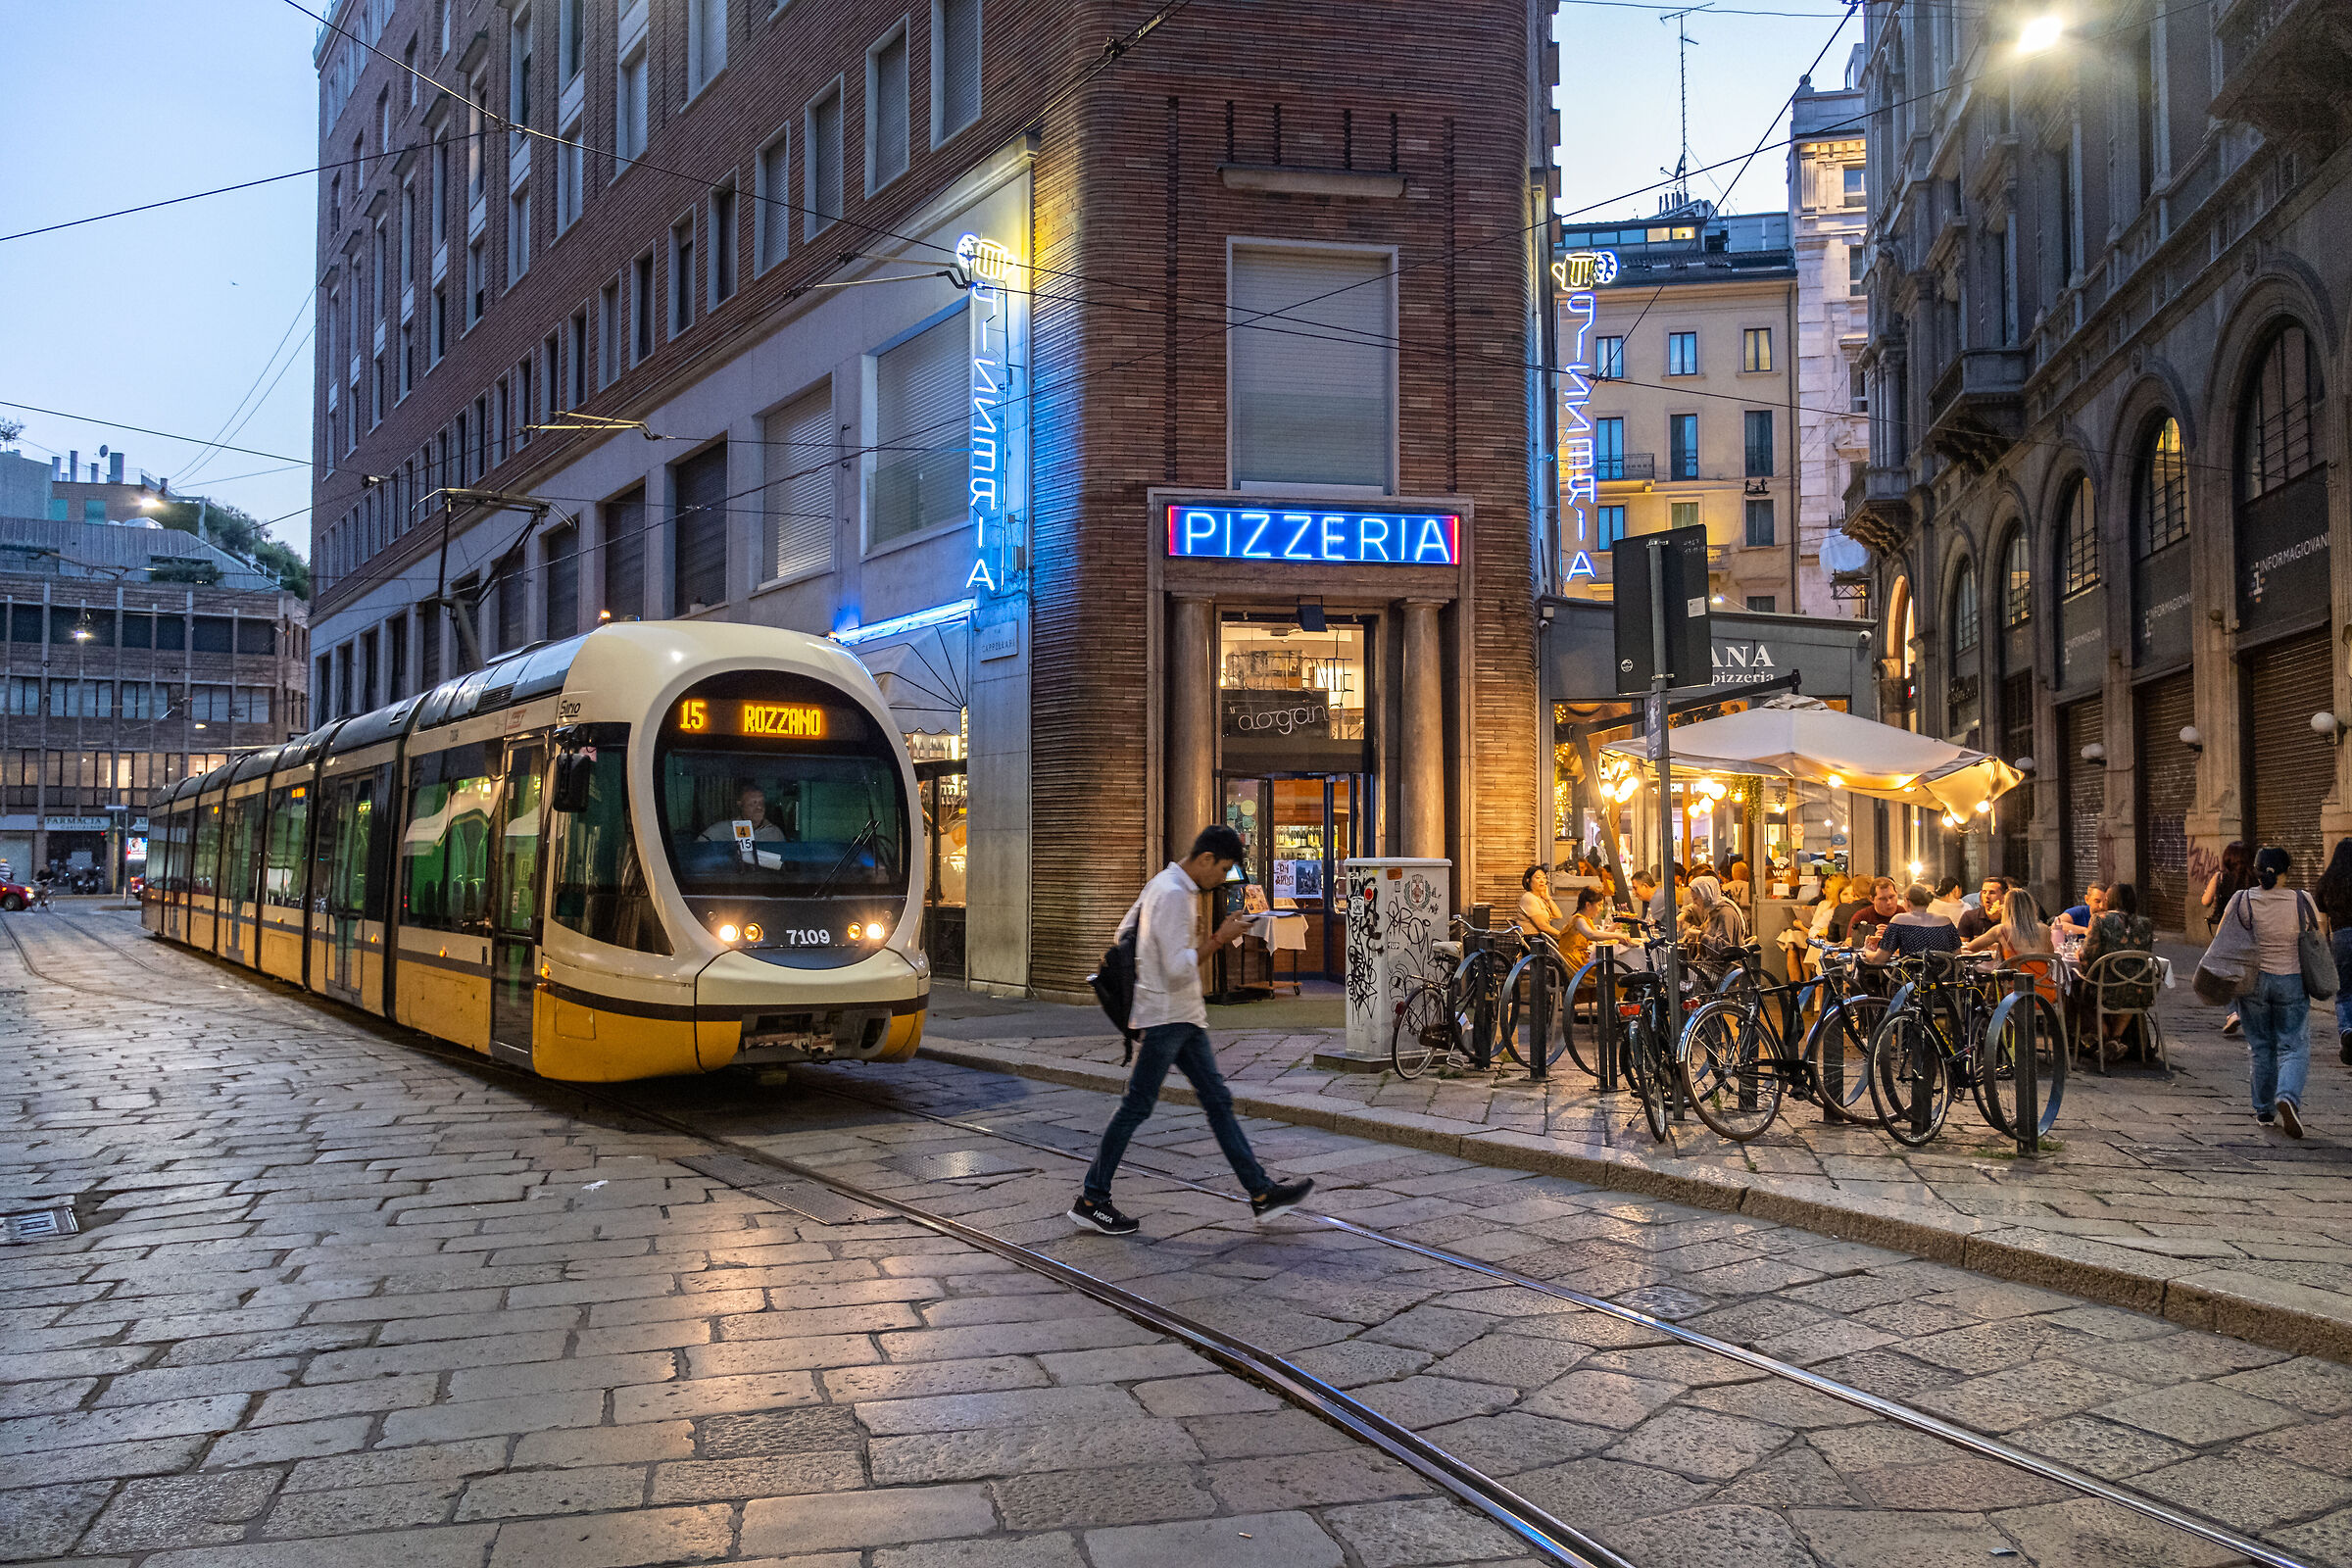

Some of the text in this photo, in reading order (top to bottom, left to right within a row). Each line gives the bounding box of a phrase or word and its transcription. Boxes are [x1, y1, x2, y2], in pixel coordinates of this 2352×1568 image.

[1184, 511, 1451, 564] PIZZERIA
[1711, 670, 1775, 687] pizzeria
[680, 701, 821, 736] 15 ROZZANO
[740, 827, 747, 837] 4
[740, 839, 752, 850] 15
[786, 929, 831, 945] 7109
[1093, 1209, 1113, 1224] HOKA
